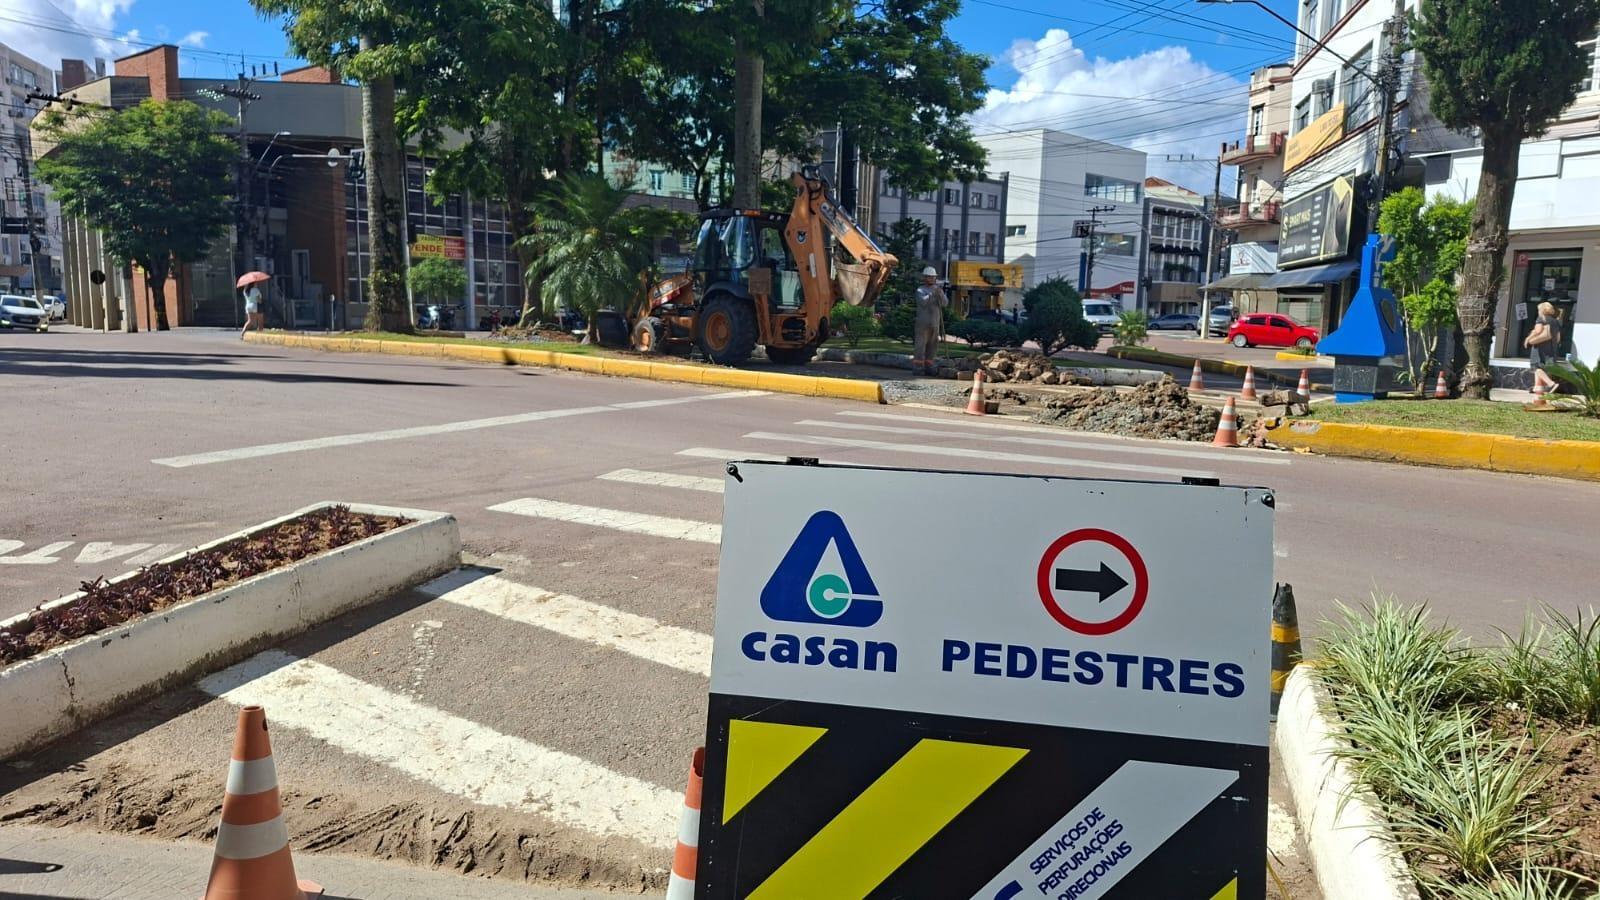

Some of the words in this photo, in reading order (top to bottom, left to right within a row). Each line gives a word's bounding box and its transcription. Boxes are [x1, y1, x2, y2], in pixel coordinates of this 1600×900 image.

[741, 631, 898, 673] casan
[942, 639, 1245, 698] PEDESTRES
[1029, 821, 1088, 875] SERVIÇOS
[1084, 807, 1106, 828] DE
[1038, 819, 1124, 895] PERFURAÇÕES
